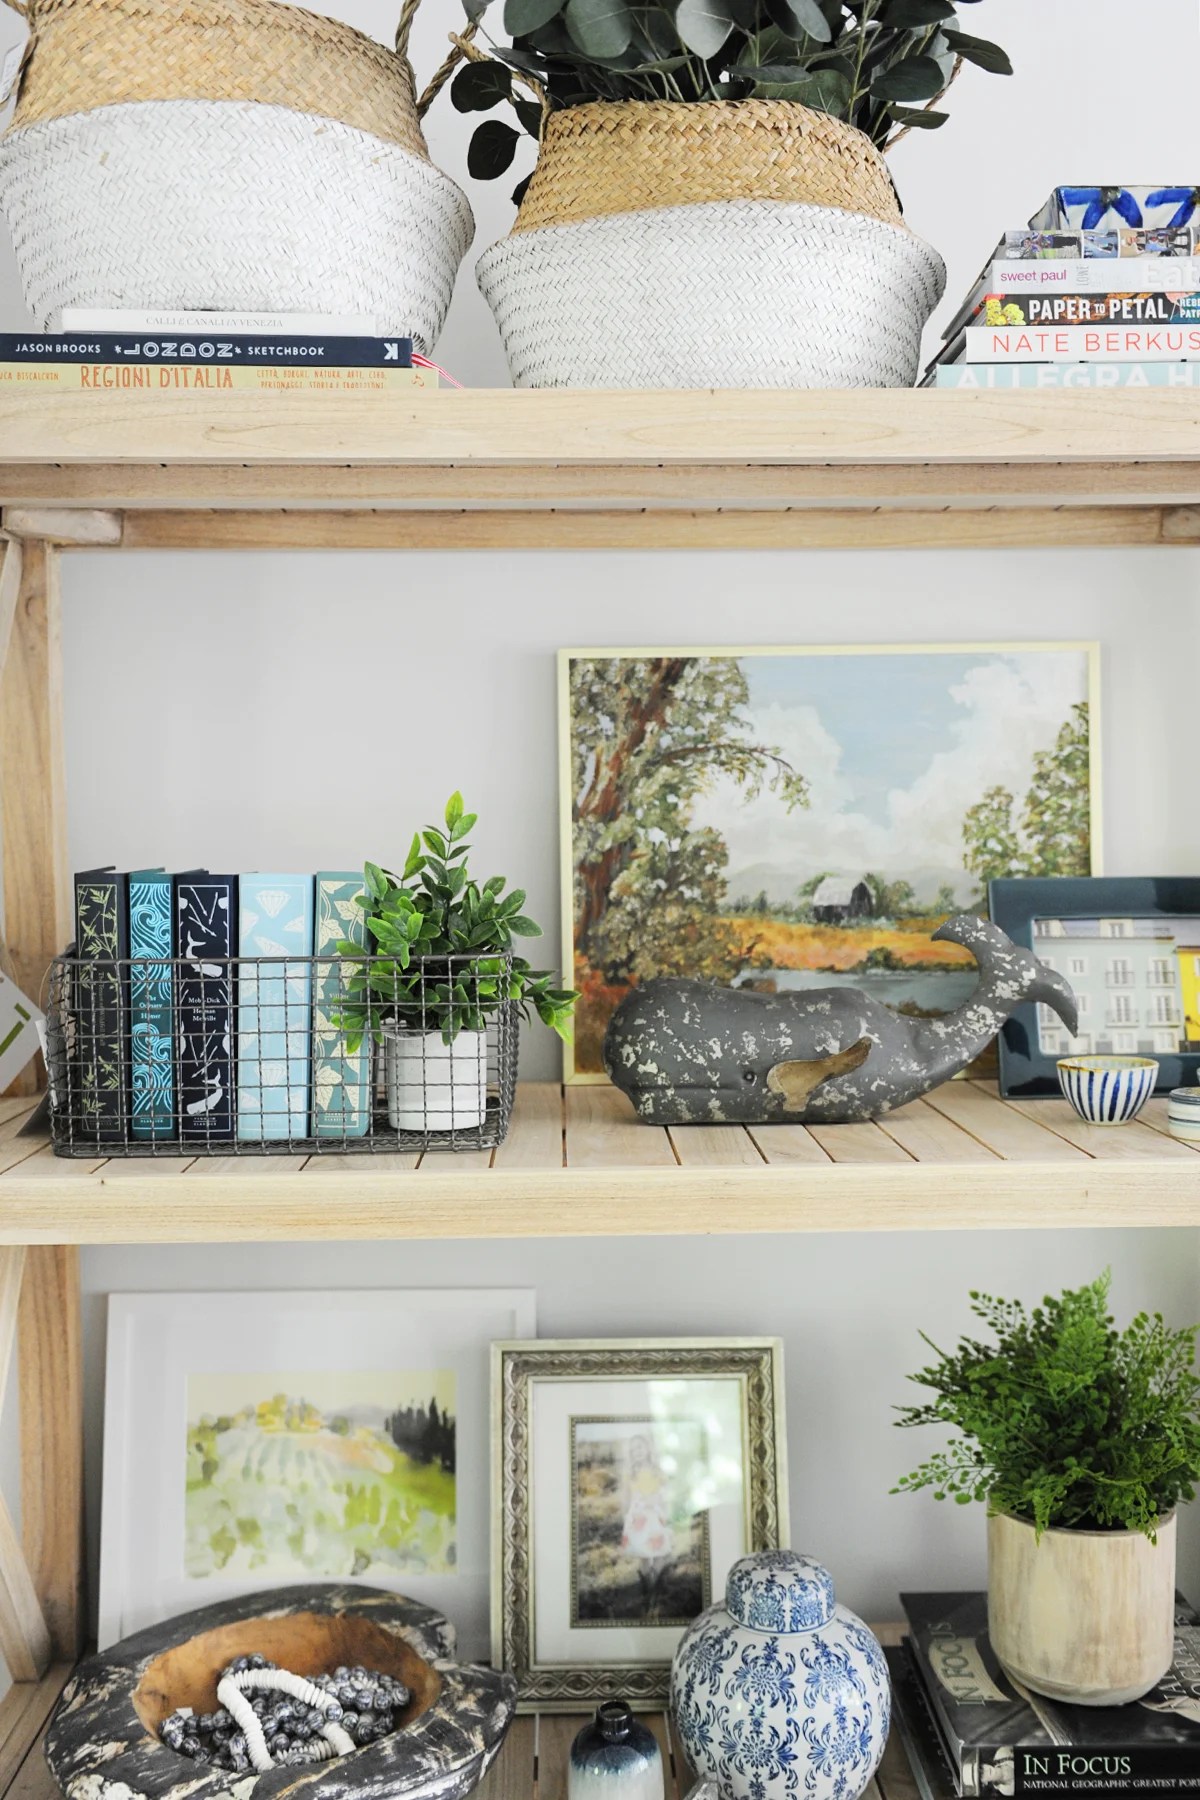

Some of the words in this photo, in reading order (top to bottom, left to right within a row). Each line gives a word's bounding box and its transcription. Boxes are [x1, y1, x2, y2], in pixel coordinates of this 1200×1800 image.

[1000, 271, 1036, 281] sweet
[1040, 269, 1067, 284] paul
[1029, 299, 1091, 320] PAPER
[1094, 304, 1106, 313] TO
[1109, 299, 1168, 319] PETAL
[15, 343, 53, 352] JASON
[55, 344, 101, 353] BROOKS
[247, 346, 325, 356] SKETCHBOOK
[993, 334, 1069, 352] NATE
[1085, 332, 1200, 351] BERKUS
[81, 365, 151, 388] REGIONI
[159, 367, 234, 388] D'ITALIA
[927, 1621, 975, 1679] FOCUS
[1023, 1780, 1070, 1789] NATIONAL
[1071, 1779, 1132, 1789] GEOGRAPHIC
[1133, 1778, 1177, 1788] GREATEST
